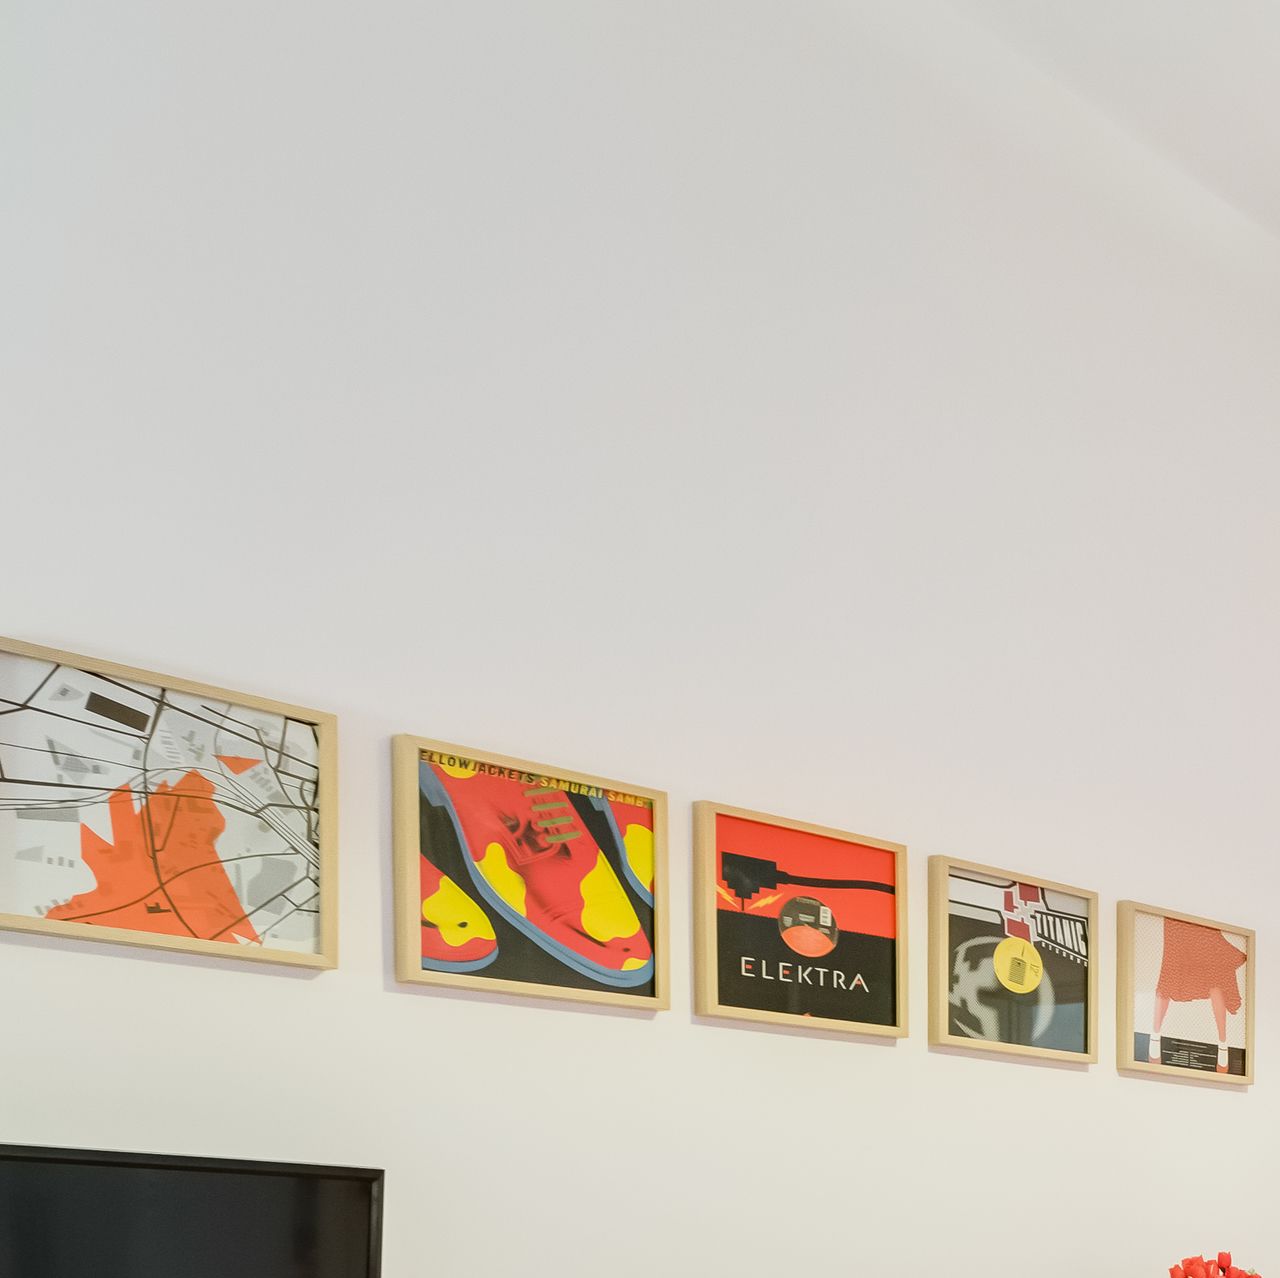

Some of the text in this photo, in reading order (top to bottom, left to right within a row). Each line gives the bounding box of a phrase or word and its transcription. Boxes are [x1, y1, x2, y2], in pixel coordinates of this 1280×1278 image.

[540, 776, 604, 799] SAMURAI
[606, 791, 650, 809] SAMB
[1035, 912, 1088, 957] TITANIC
[740, 956, 870, 993] ELEKTRA
